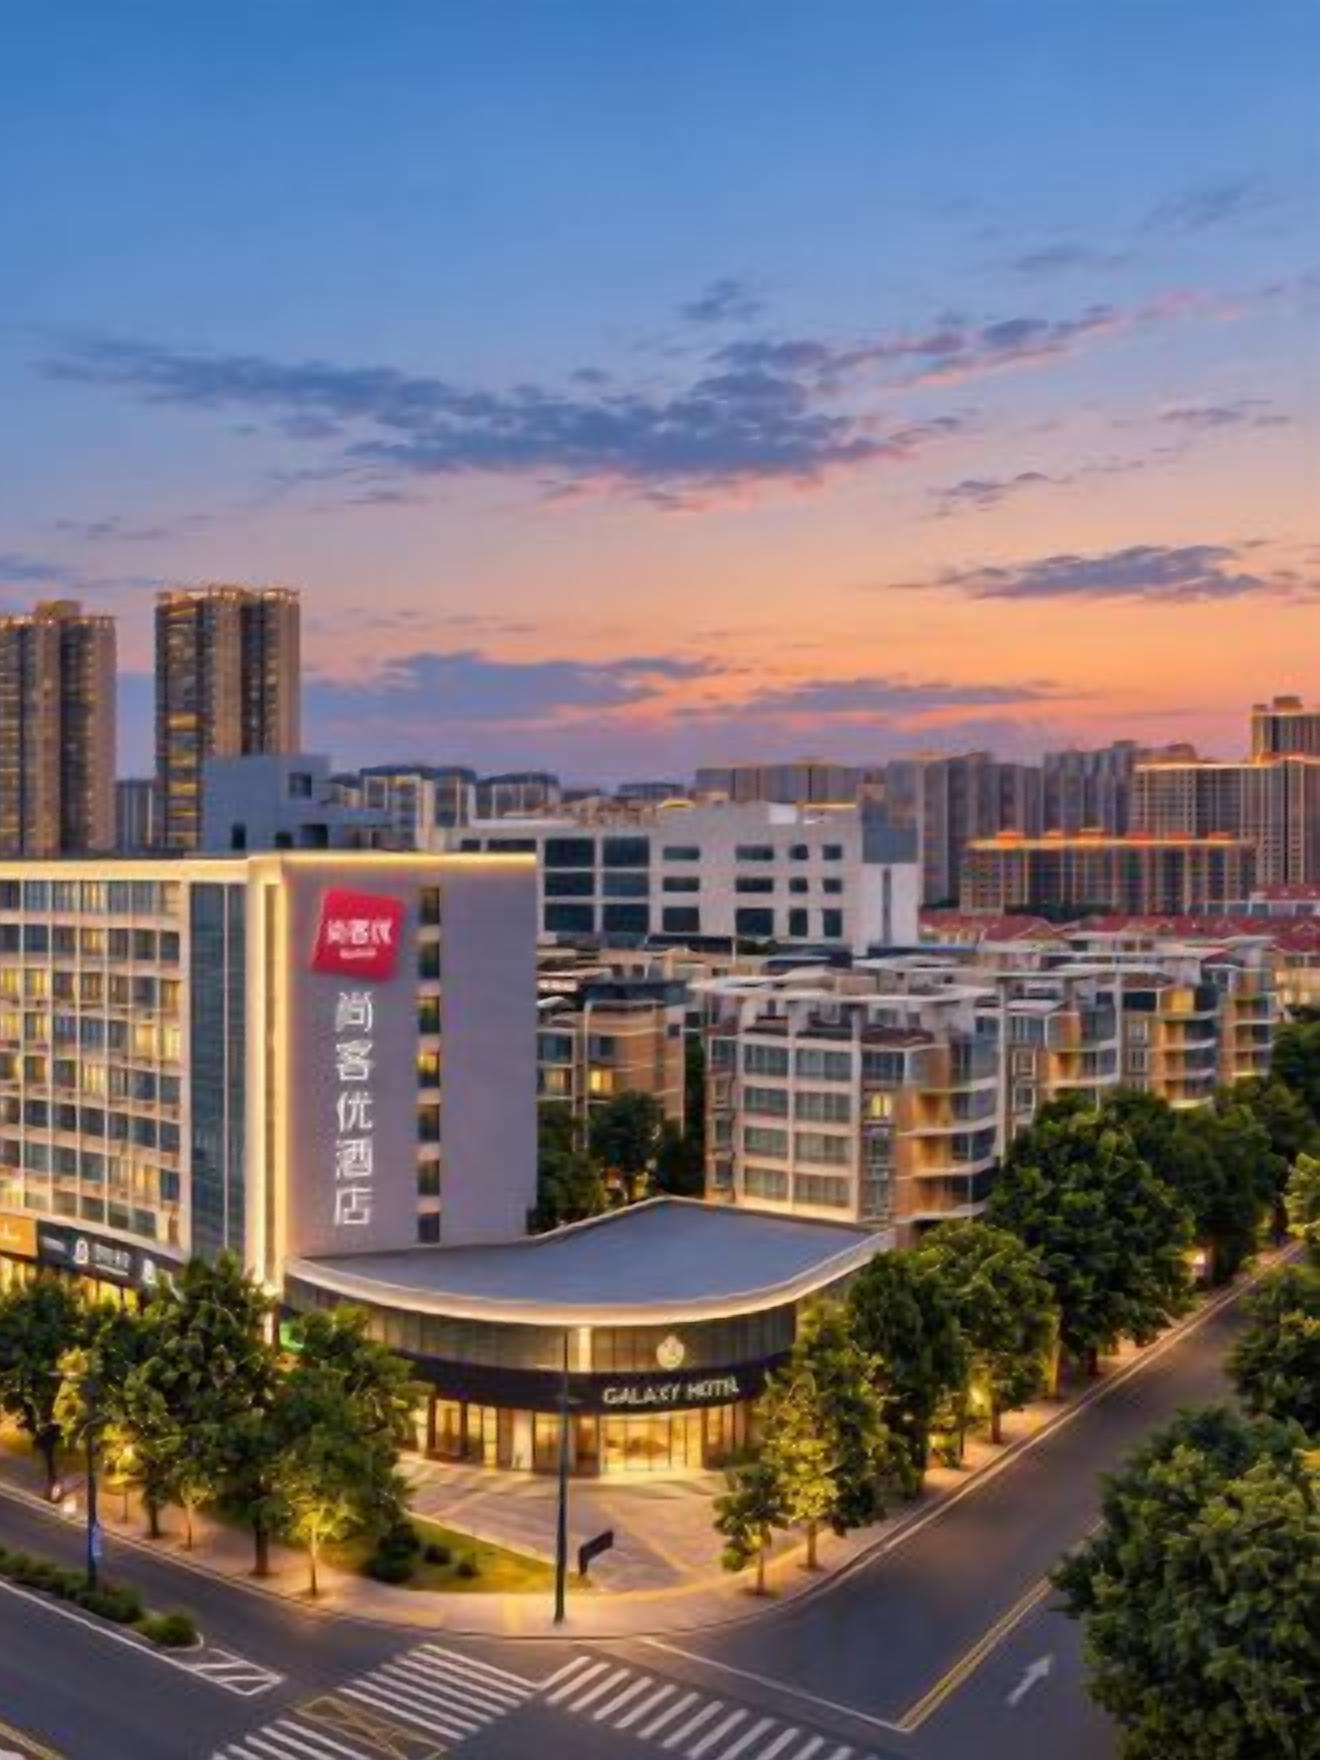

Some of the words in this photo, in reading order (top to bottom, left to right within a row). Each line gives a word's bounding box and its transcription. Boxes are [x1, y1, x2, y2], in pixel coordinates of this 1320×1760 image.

[335, 991, 373, 1225] 尚客优酒店
[603, 1382, 680, 1405] GALAXY
